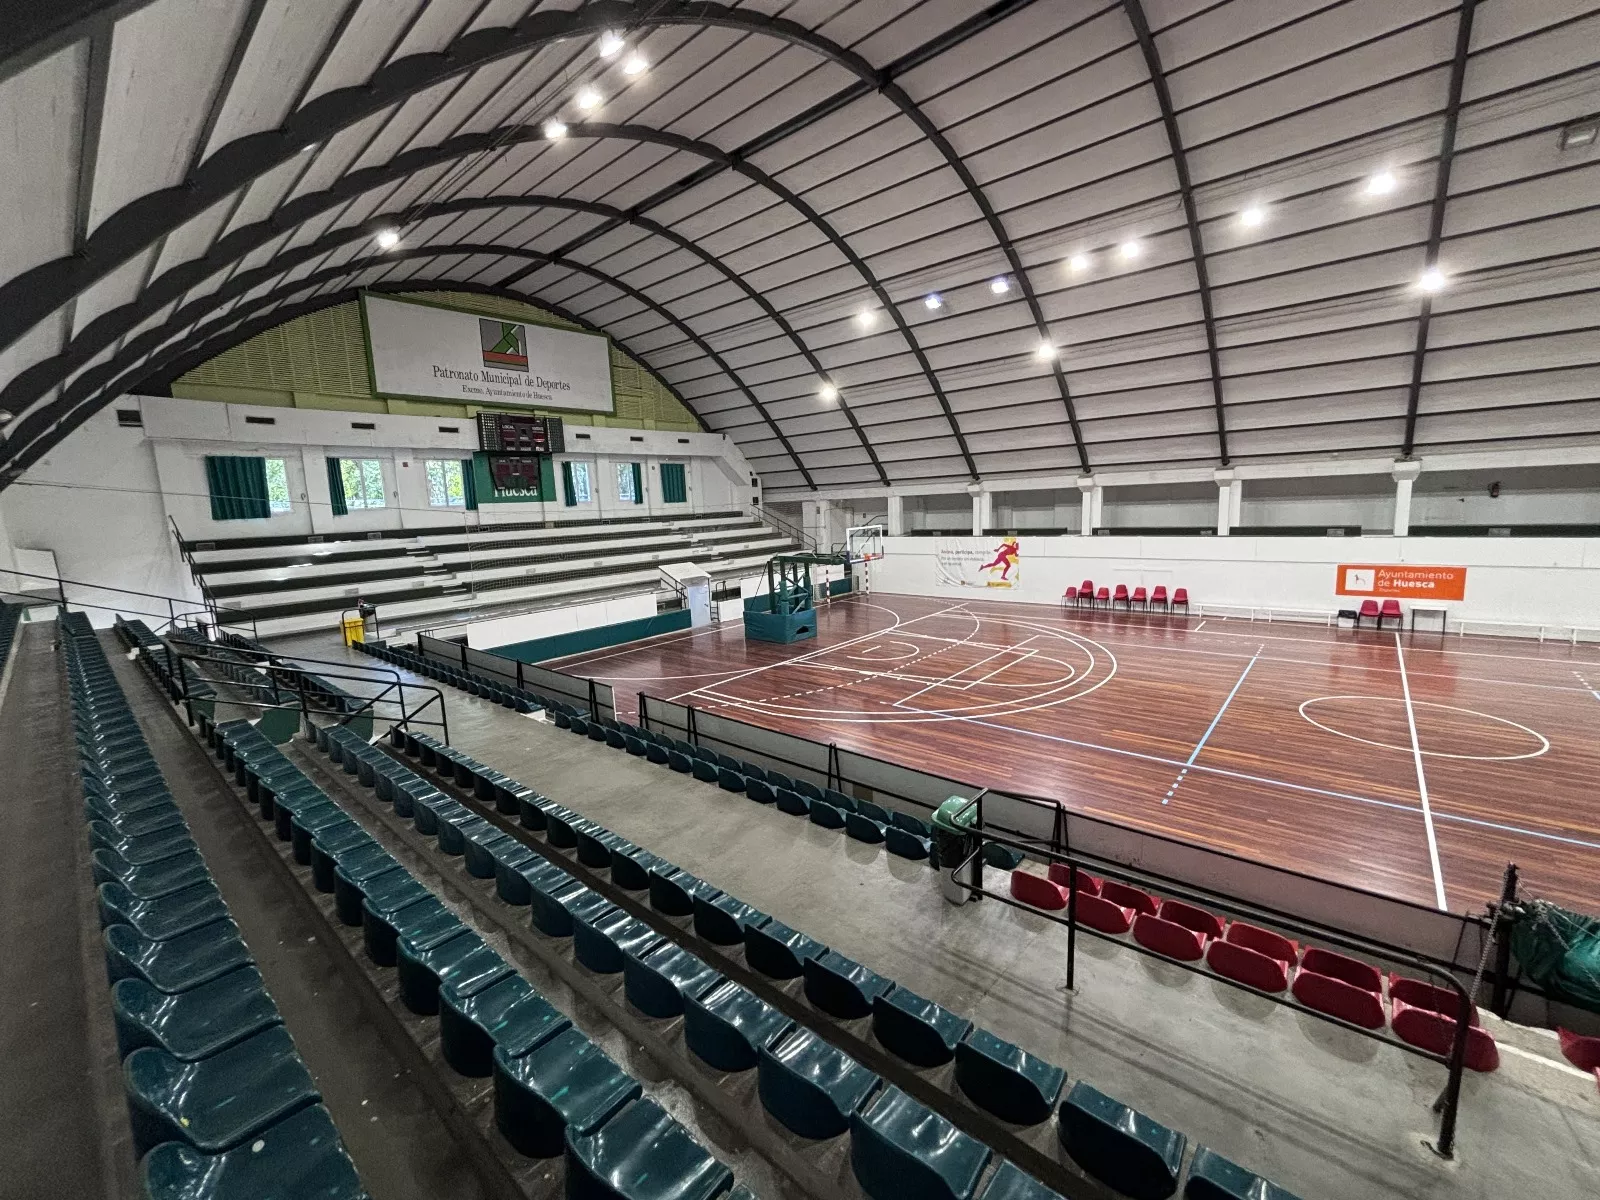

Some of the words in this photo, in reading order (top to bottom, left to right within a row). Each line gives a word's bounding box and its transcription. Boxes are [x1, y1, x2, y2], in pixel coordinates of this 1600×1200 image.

[432, 365, 479, 382] Patronato
[481, 370, 522, 386] Municipal
[524, 375, 535, 386] de
[536, 377, 571, 391] Deportes
[485, 387, 526, 399] Ayuntamiento
[533, 392, 553, 401] Huesca
[1378, 569, 1454, 580] Ayuntamiento
[1378, 579, 1390, 587] de
[1393, 579, 1435, 589] Huesca
